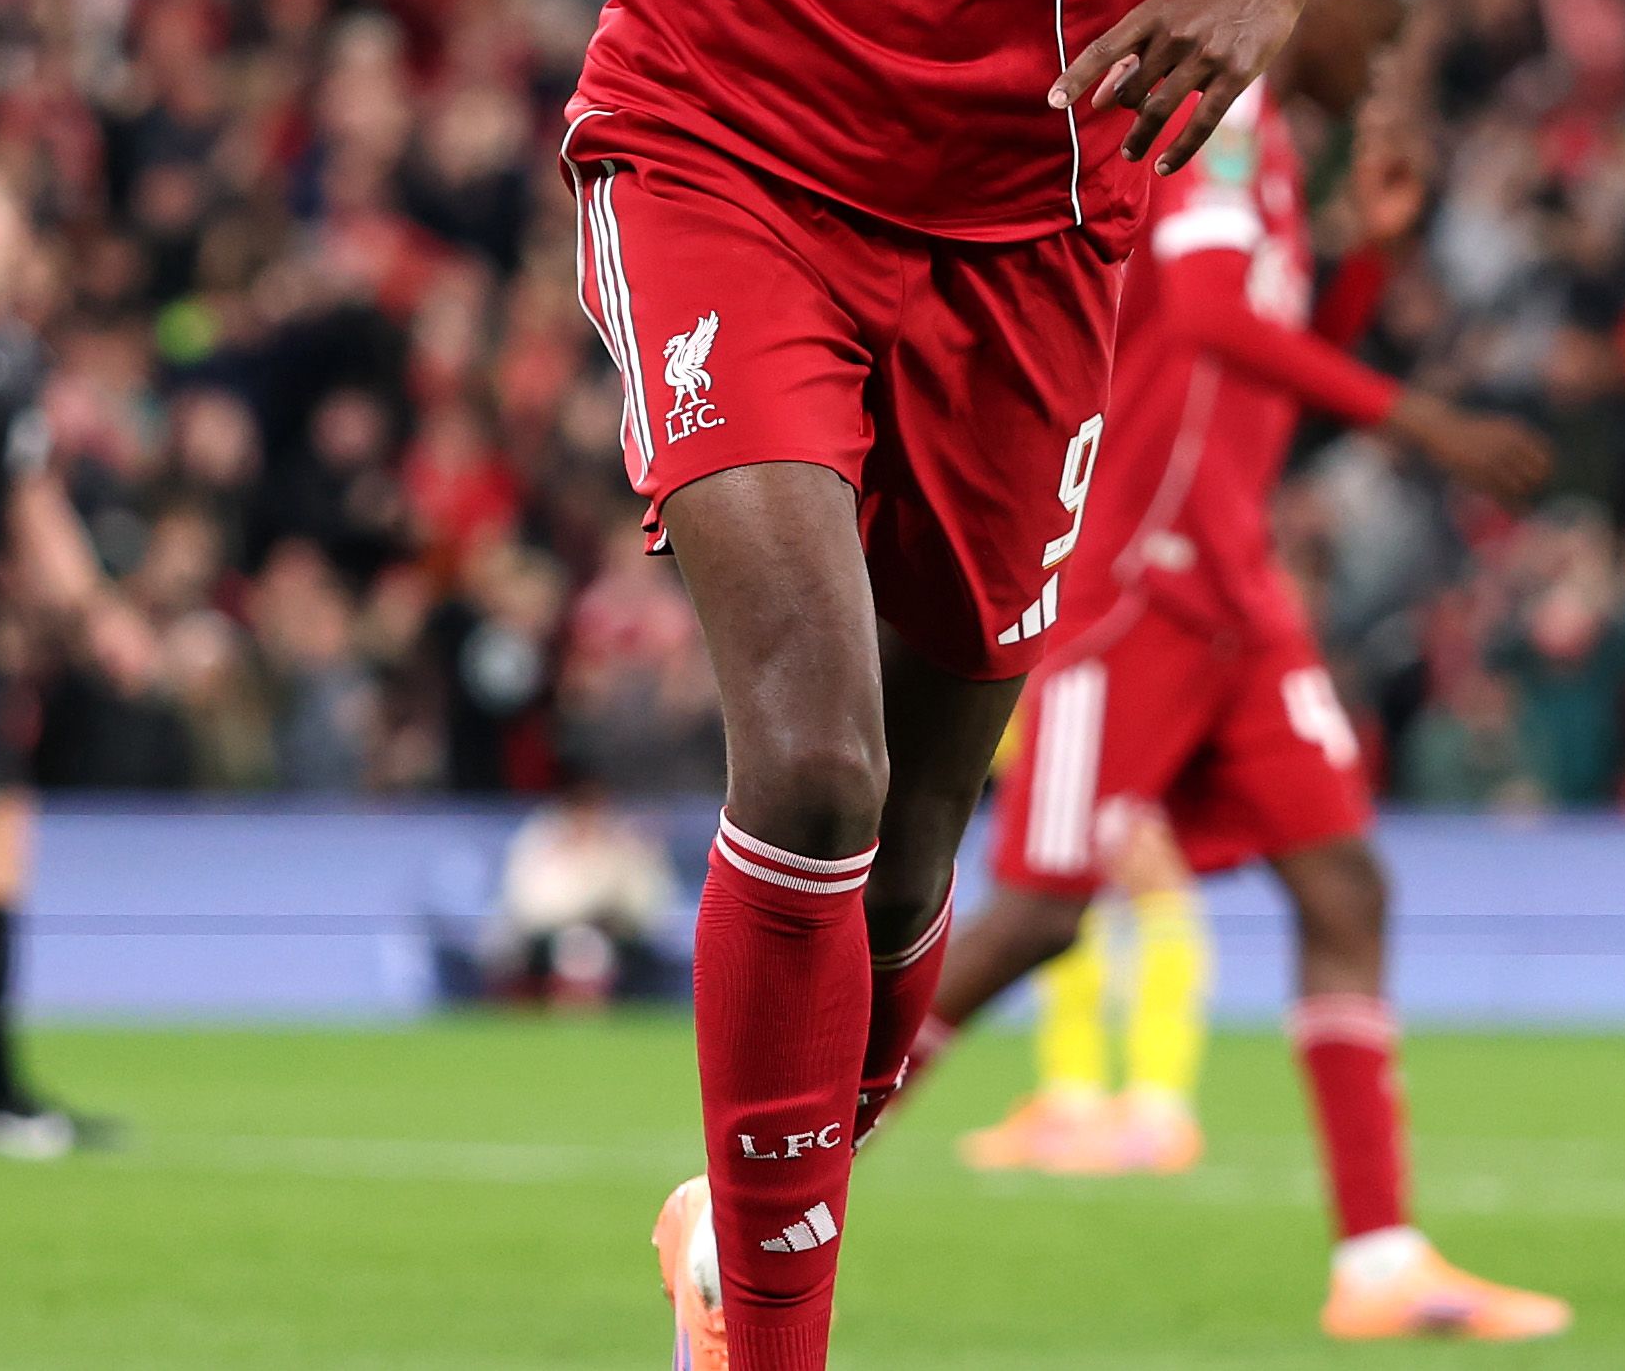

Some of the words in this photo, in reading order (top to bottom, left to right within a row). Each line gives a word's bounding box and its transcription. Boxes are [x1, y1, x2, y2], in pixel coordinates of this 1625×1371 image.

[665, 403, 726, 445] L.F.C.
[1041, 412, 1104, 570] 9
[738, 1122, 841, 1159] LFC
